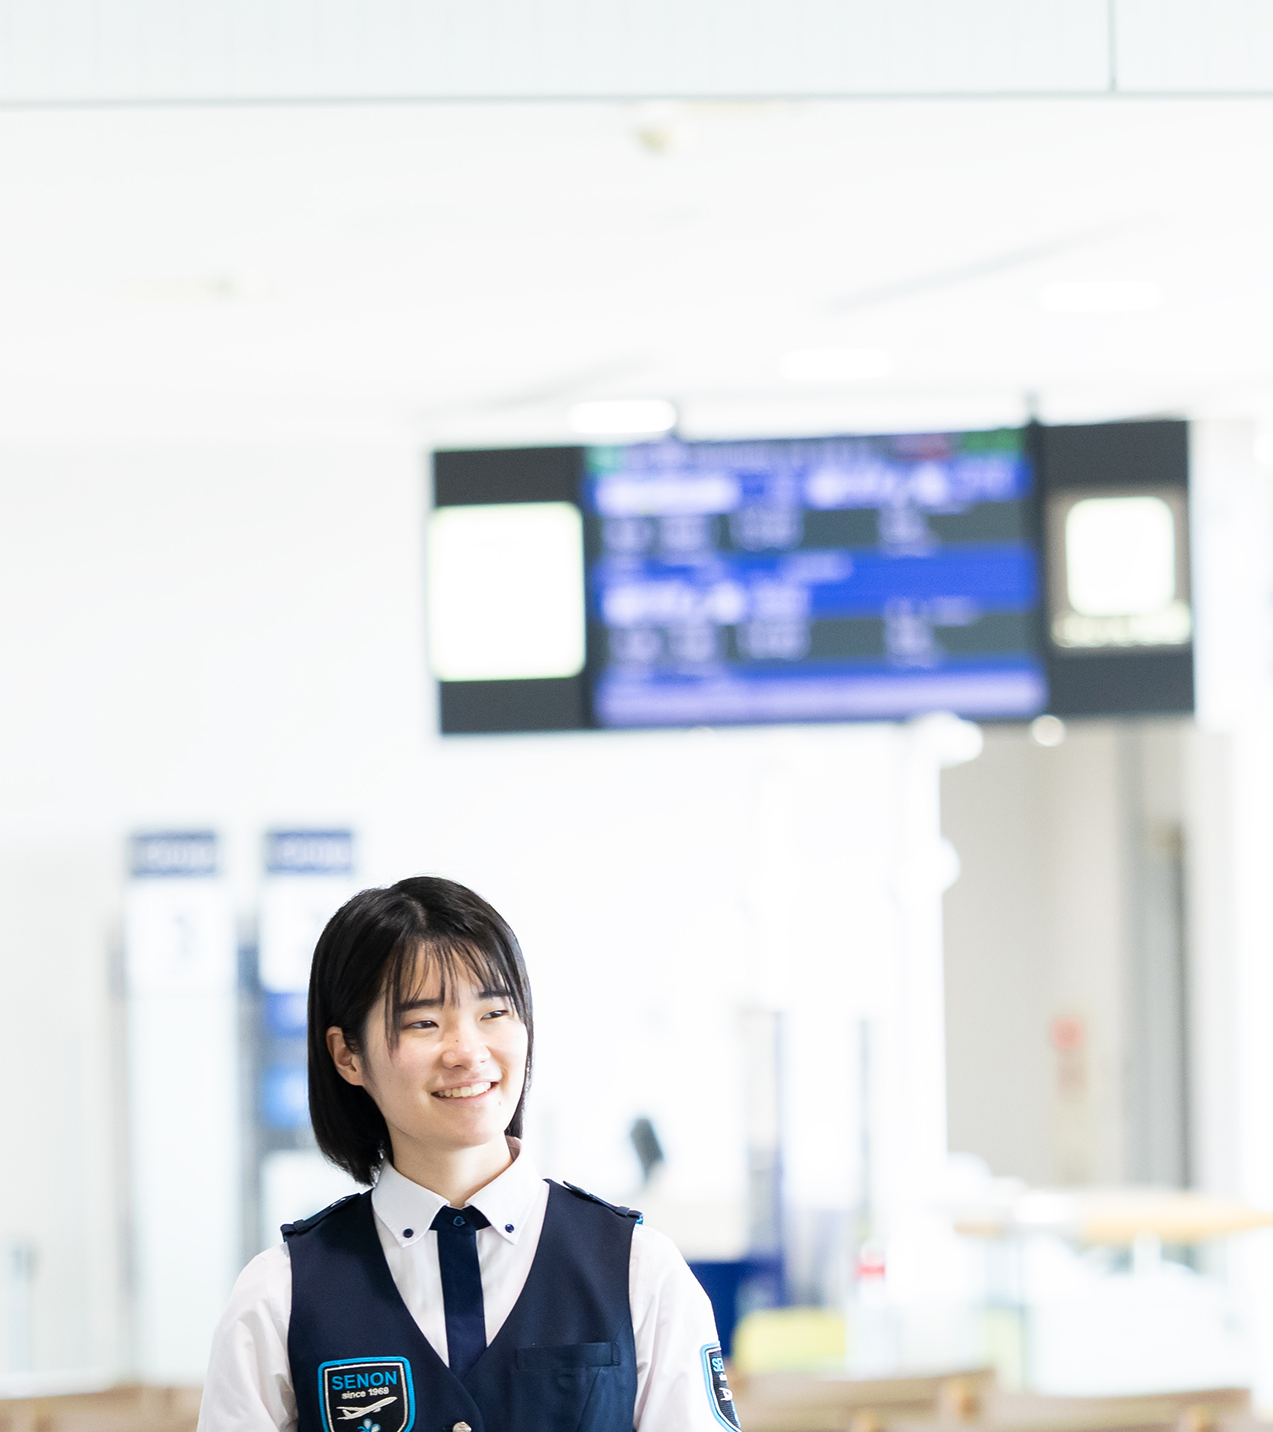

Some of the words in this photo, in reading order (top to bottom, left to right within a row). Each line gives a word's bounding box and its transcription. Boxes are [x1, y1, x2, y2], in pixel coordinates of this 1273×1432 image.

[332, 1371, 397, 1390] SENON
[341, 1391, 366, 1399] since
[368, 1387, 389, 1397] 1969
